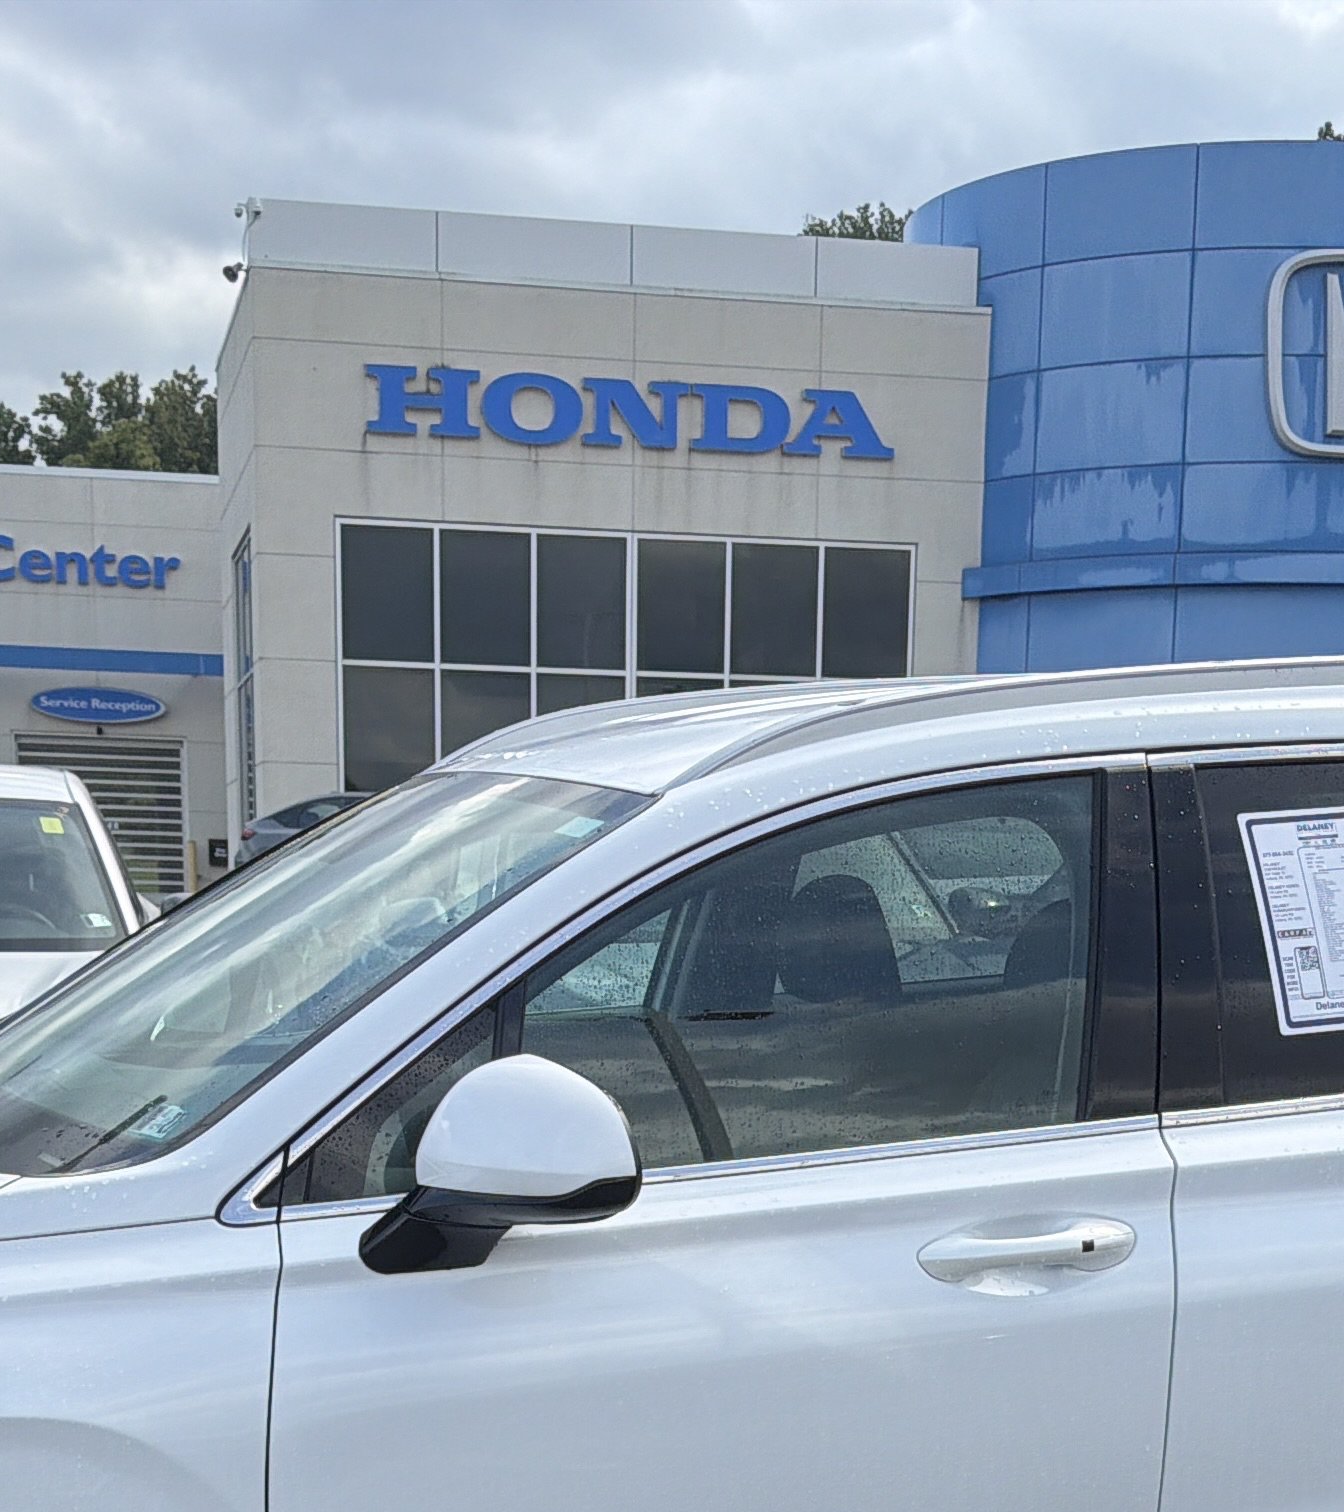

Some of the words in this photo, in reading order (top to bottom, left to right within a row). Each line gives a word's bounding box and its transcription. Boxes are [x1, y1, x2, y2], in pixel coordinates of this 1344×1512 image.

[365, 363, 895, 460] HONDA
[39, 695, 88, 708] Service
[91, 698, 156, 712] Reception
[1296, 822, 1334, 832] DELANEY
